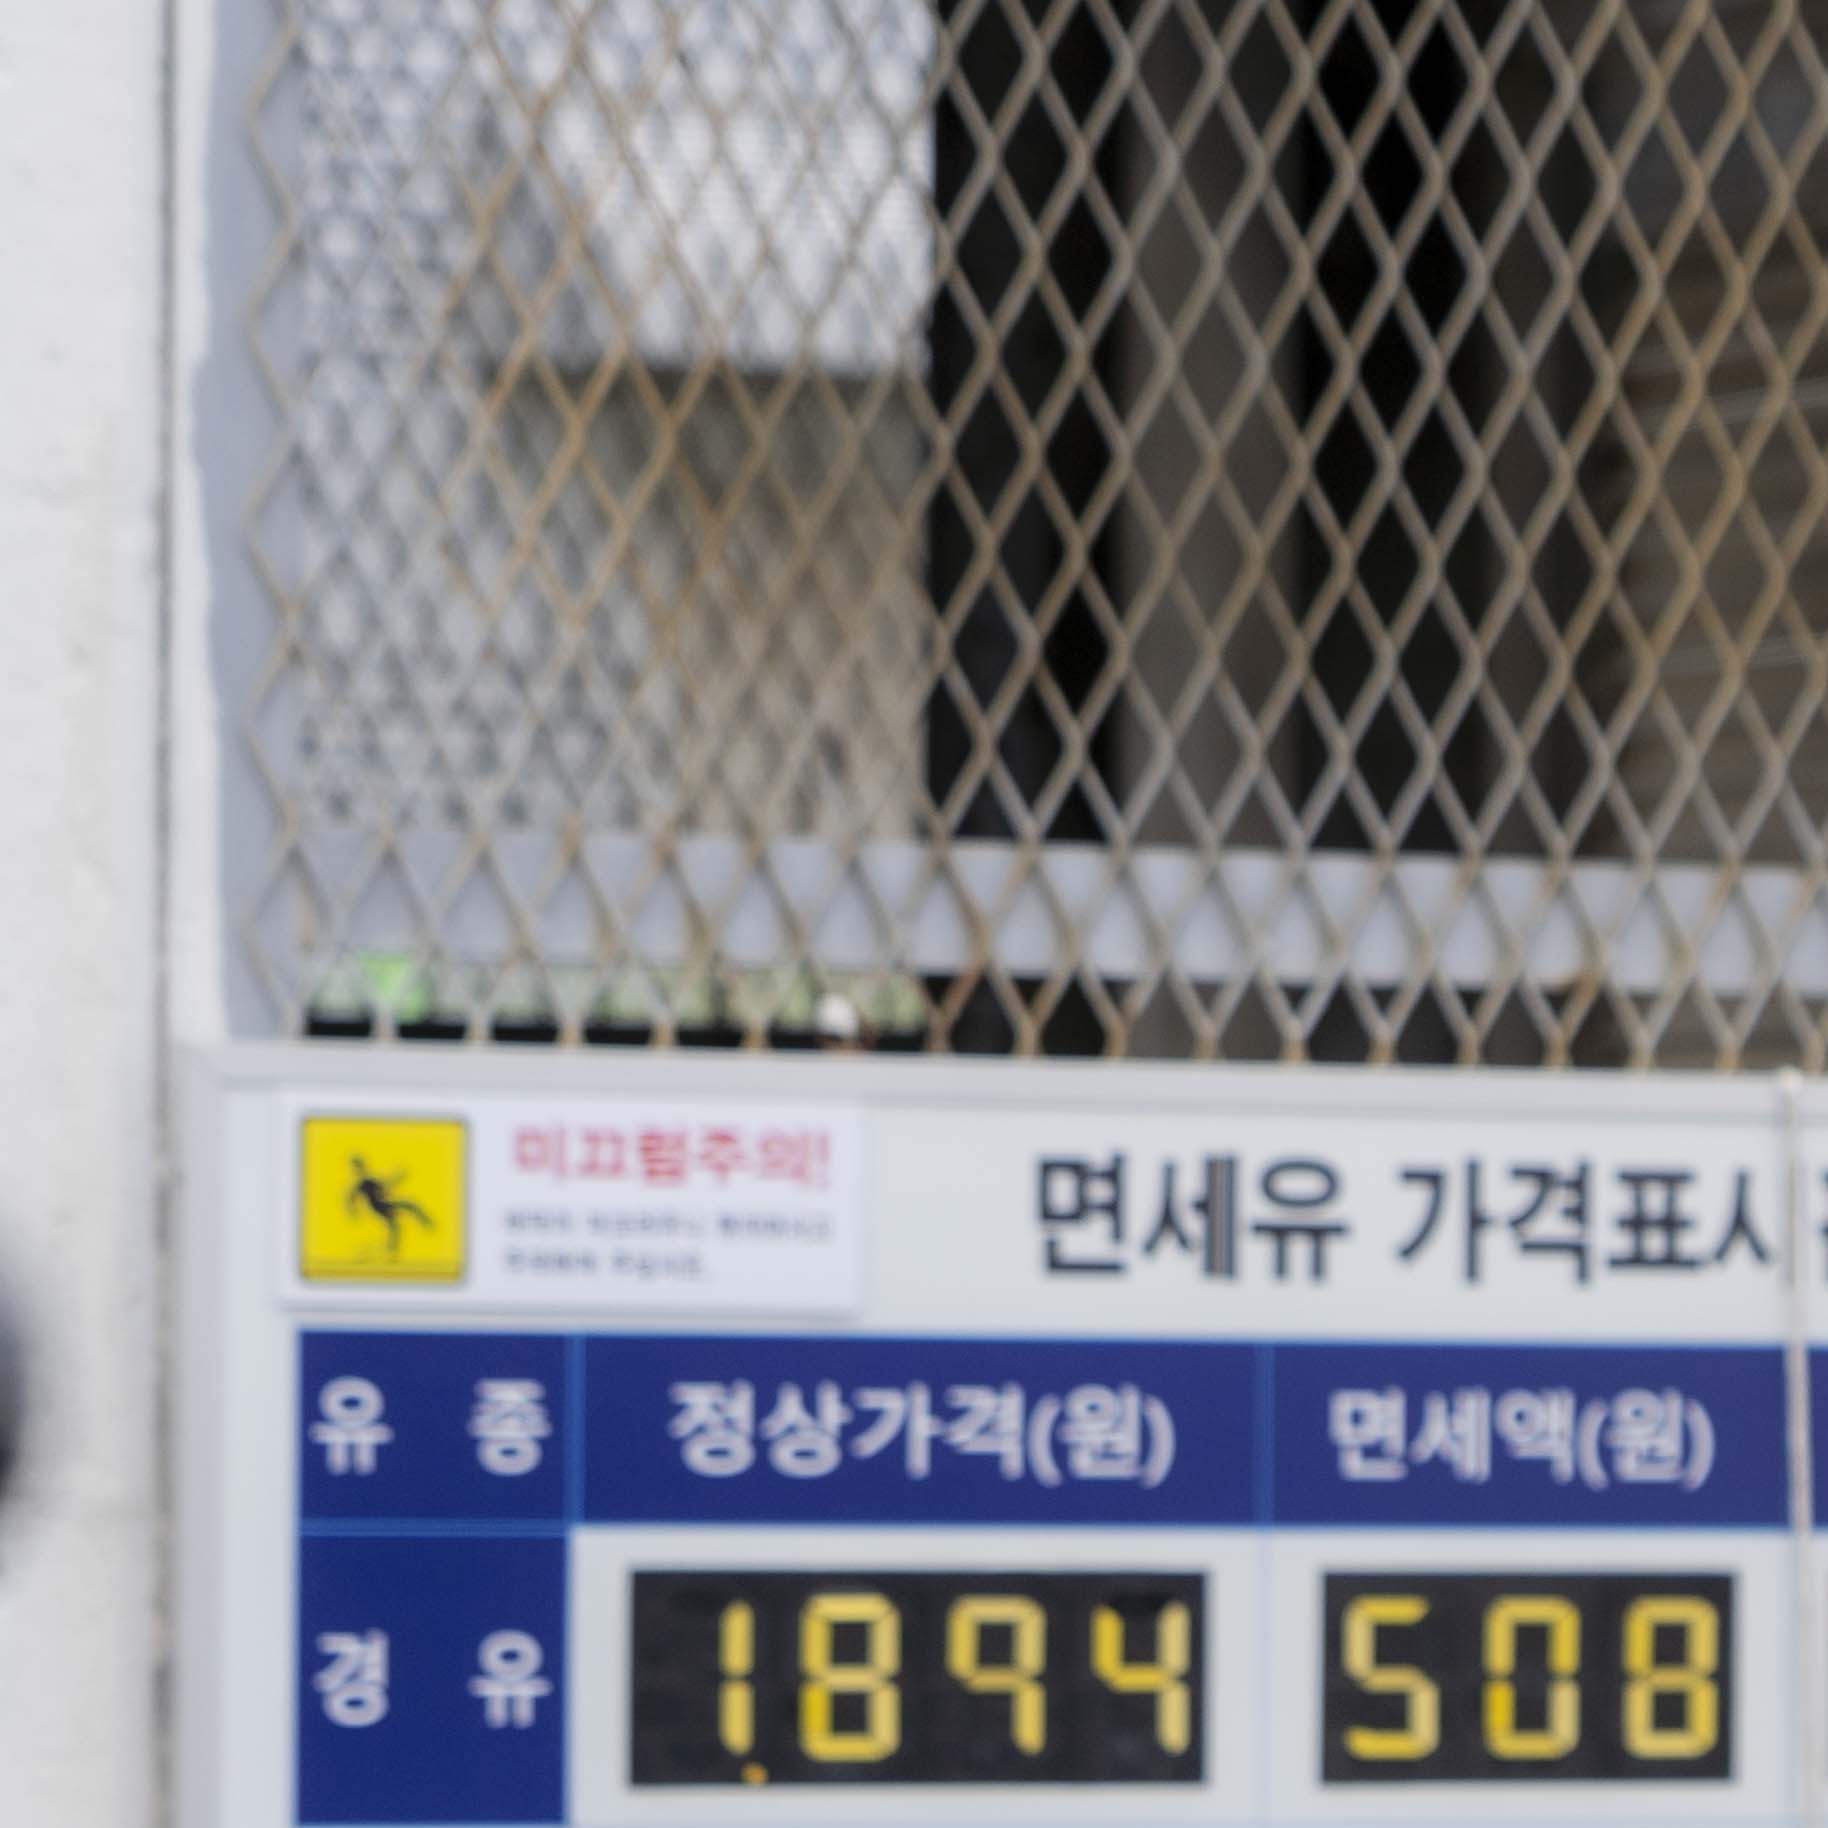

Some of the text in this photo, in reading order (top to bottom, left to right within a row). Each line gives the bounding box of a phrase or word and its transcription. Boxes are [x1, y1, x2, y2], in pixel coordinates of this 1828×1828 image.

[1035, 1151, 1347, 1284] 면세유
[668, 1381, 1175, 1488] 정상가격(원)
[1329, 1386, 1716, 1491] 면세액(원)
[1342, 1594, 1720, 1760] 508
